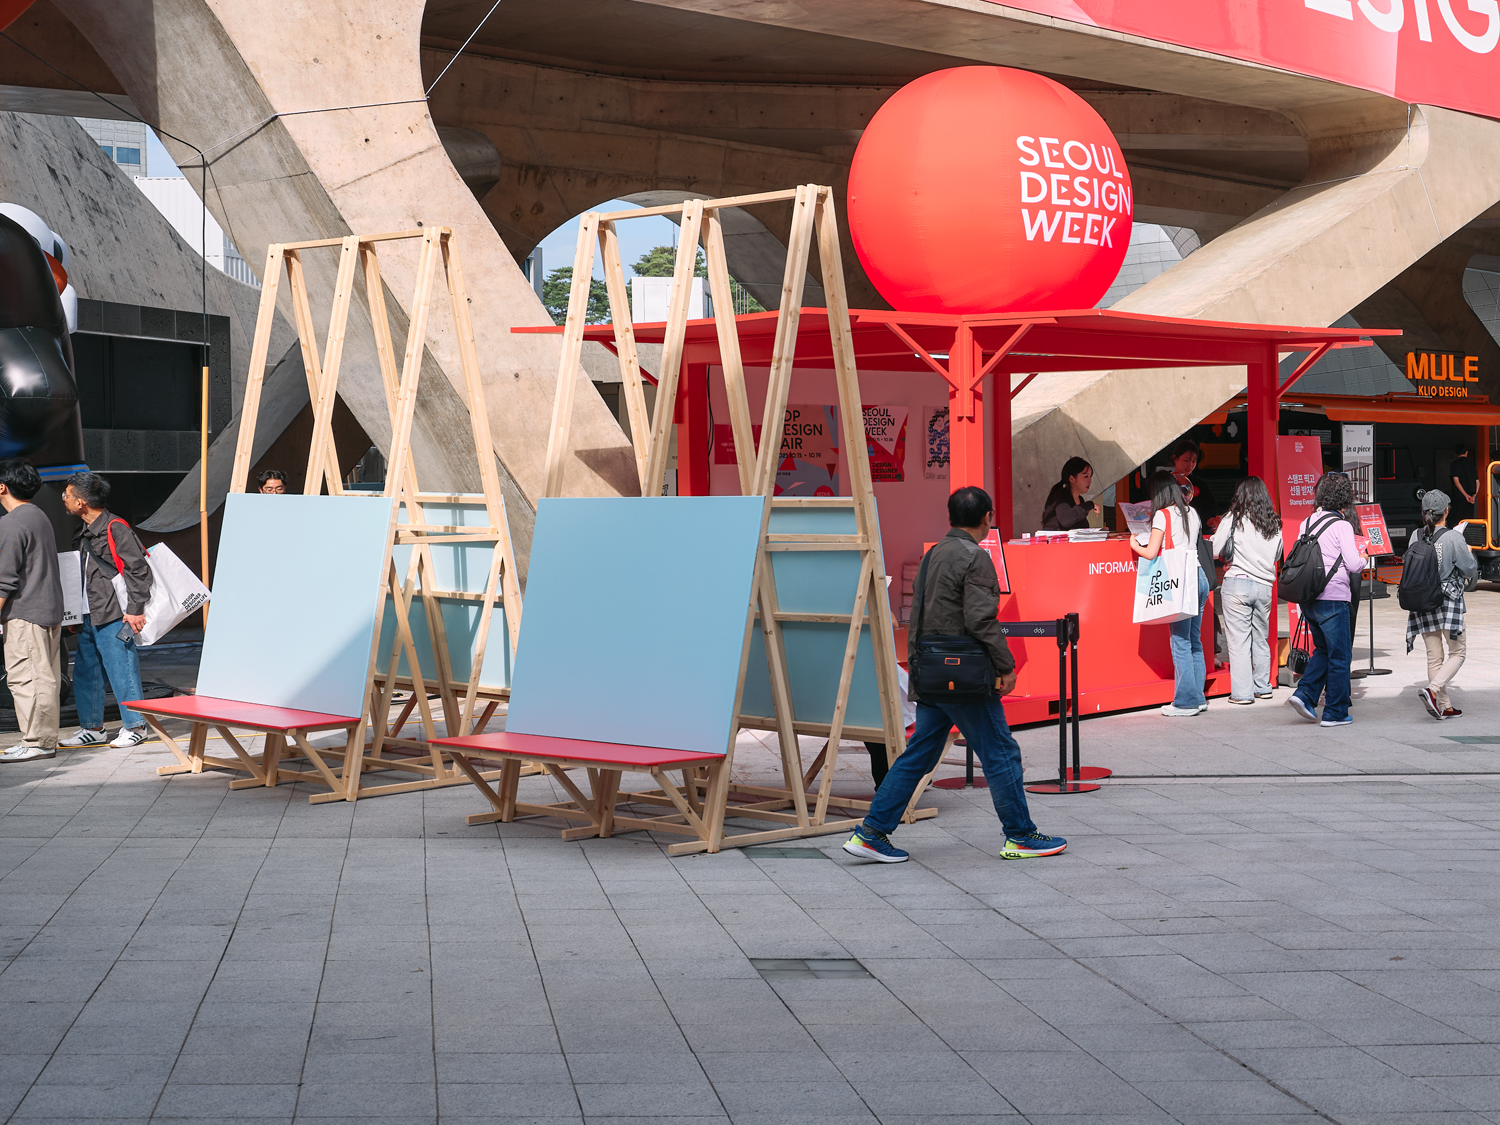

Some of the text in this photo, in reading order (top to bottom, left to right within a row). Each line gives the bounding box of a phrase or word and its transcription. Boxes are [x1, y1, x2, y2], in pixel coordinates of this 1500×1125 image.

[1016, 135, 1123, 179] SEOUL
[1020, 171, 1131, 216] DESIGN
[1021, 208, 1116, 248] WEEK
[1405, 352, 1479, 382] MULE
[1418, 385, 1468, 398] KLIO DESIGN
[784, 410, 801, 422] DP
[862, 408, 891, 417] SEOUL
[863, 418, 896, 427] DESIGN
[784, 424, 823, 436] ESIGN
[780, 437, 803, 450] AIR
[1287, 474, 1315, 484] 스탬프 찍고
[1290, 486, 1301, 495] 선물
[1001, 627, 1045, 635] dp ddp
